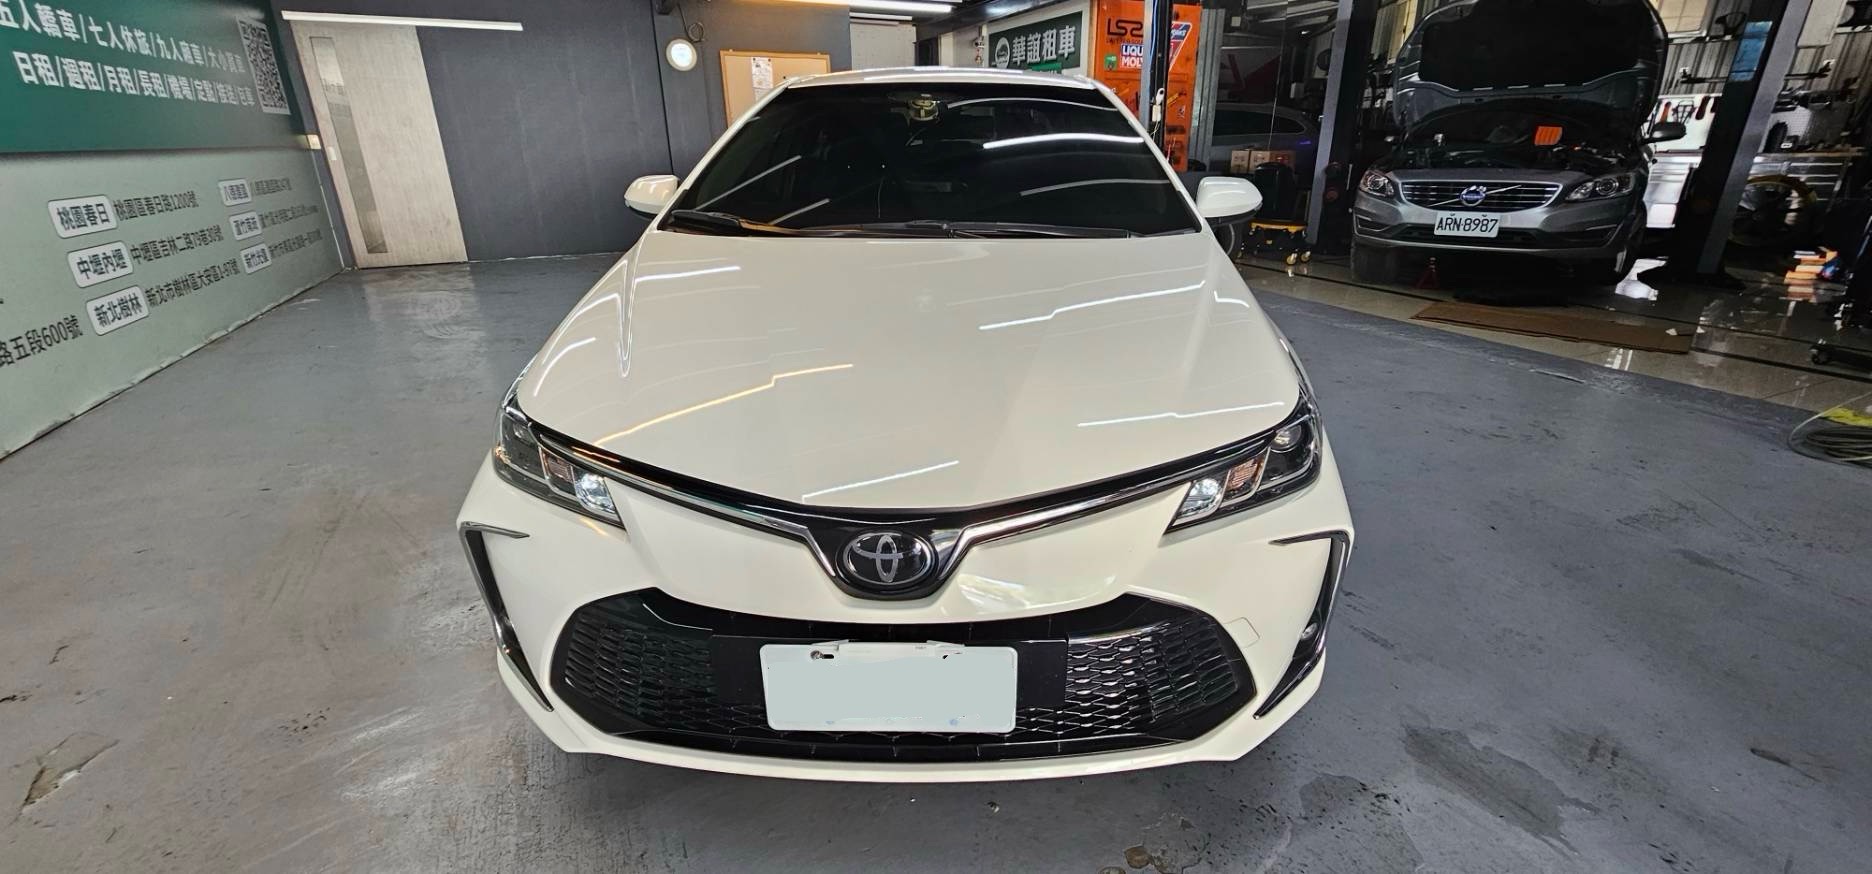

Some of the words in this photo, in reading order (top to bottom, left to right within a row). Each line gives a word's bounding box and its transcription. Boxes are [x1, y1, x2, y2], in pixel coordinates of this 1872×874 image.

[1012, 25, 1076, 65] 華誼租車
[1122, 45, 1144, 56] LIQU
[57, 203, 110, 231] 桃園春日
[93, 292, 143, 328] 新北樹林
